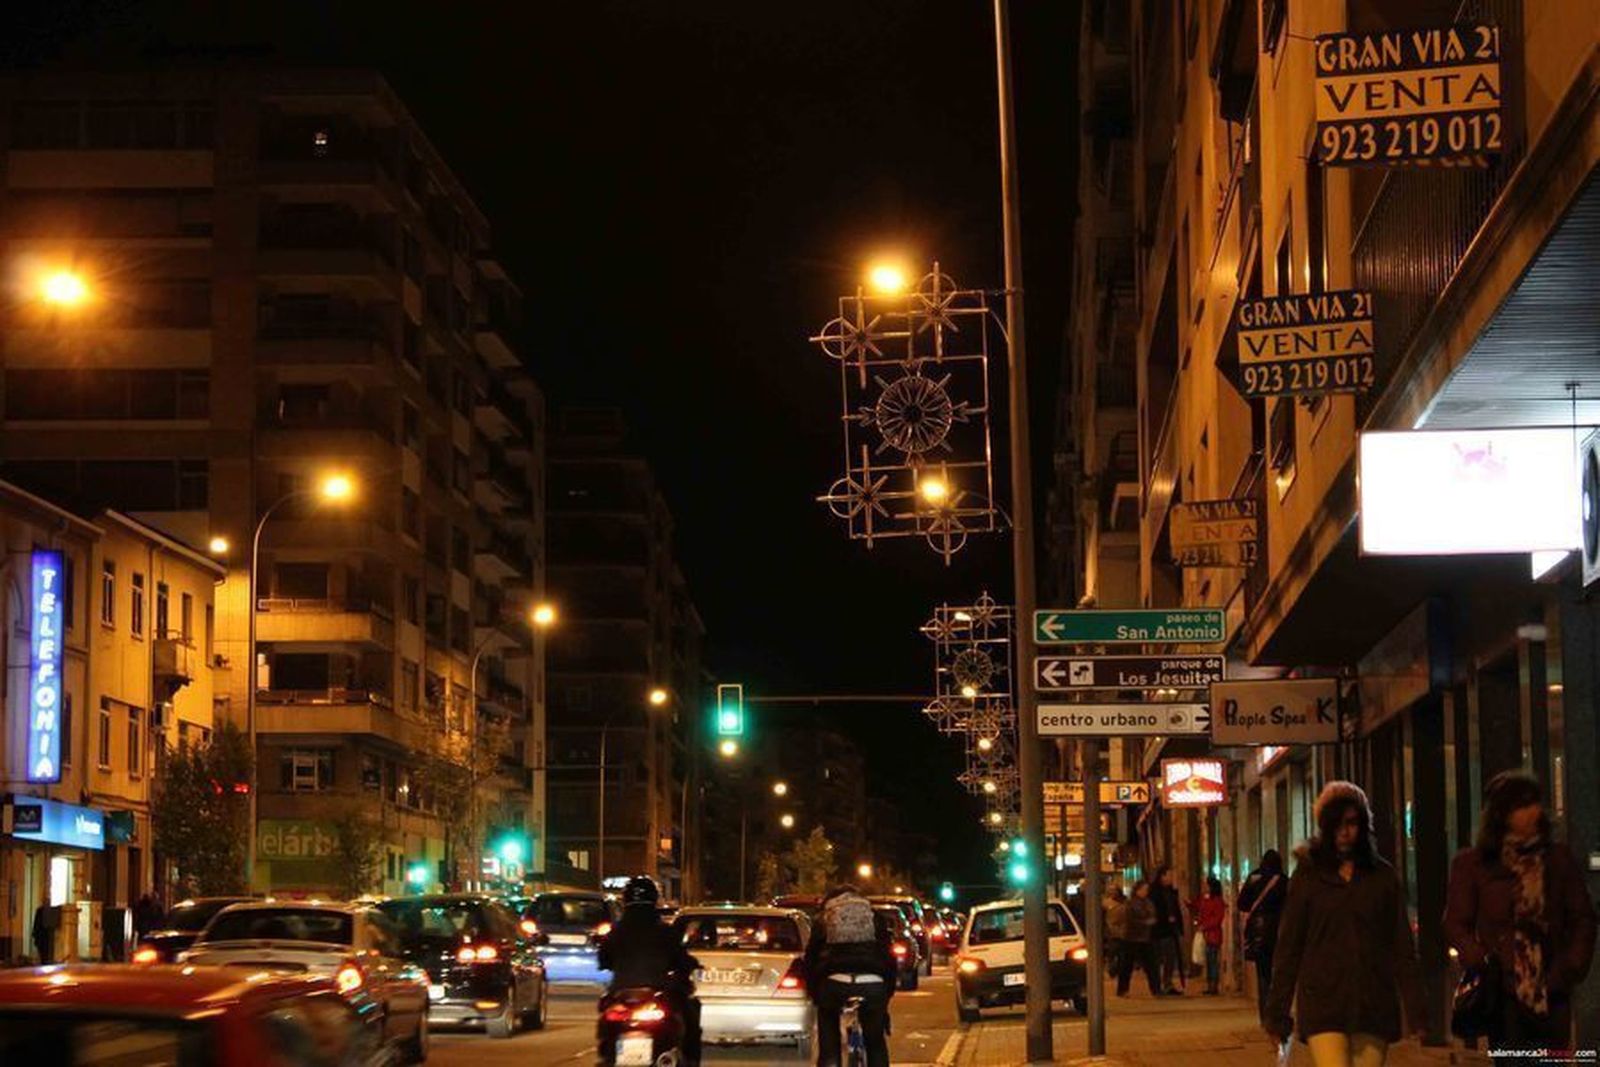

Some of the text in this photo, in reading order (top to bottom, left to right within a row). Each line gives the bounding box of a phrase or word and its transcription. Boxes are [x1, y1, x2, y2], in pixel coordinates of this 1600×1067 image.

[1318, 26, 1499, 72] GRAN VIA 21
[1324, 73, 1500, 113] VENTA
[1322, 113, 1501, 162] 923 219 012
[1239, 293, 1372, 327] GRAN VIA 21
[1244, 327, 1372, 357] VENTA
[1244, 357, 1374, 394] 923 219 012
[1117, 625, 1219, 639] San Antonio
[1166, 612, 1219, 624] paseo de
[36, 569, 56, 778] TELEFONIA
[1119, 671, 1220, 686] Los Jesuitas
[1161, 659, 1220, 671] parque de
[1041, 711, 1158, 726] centro urbano
